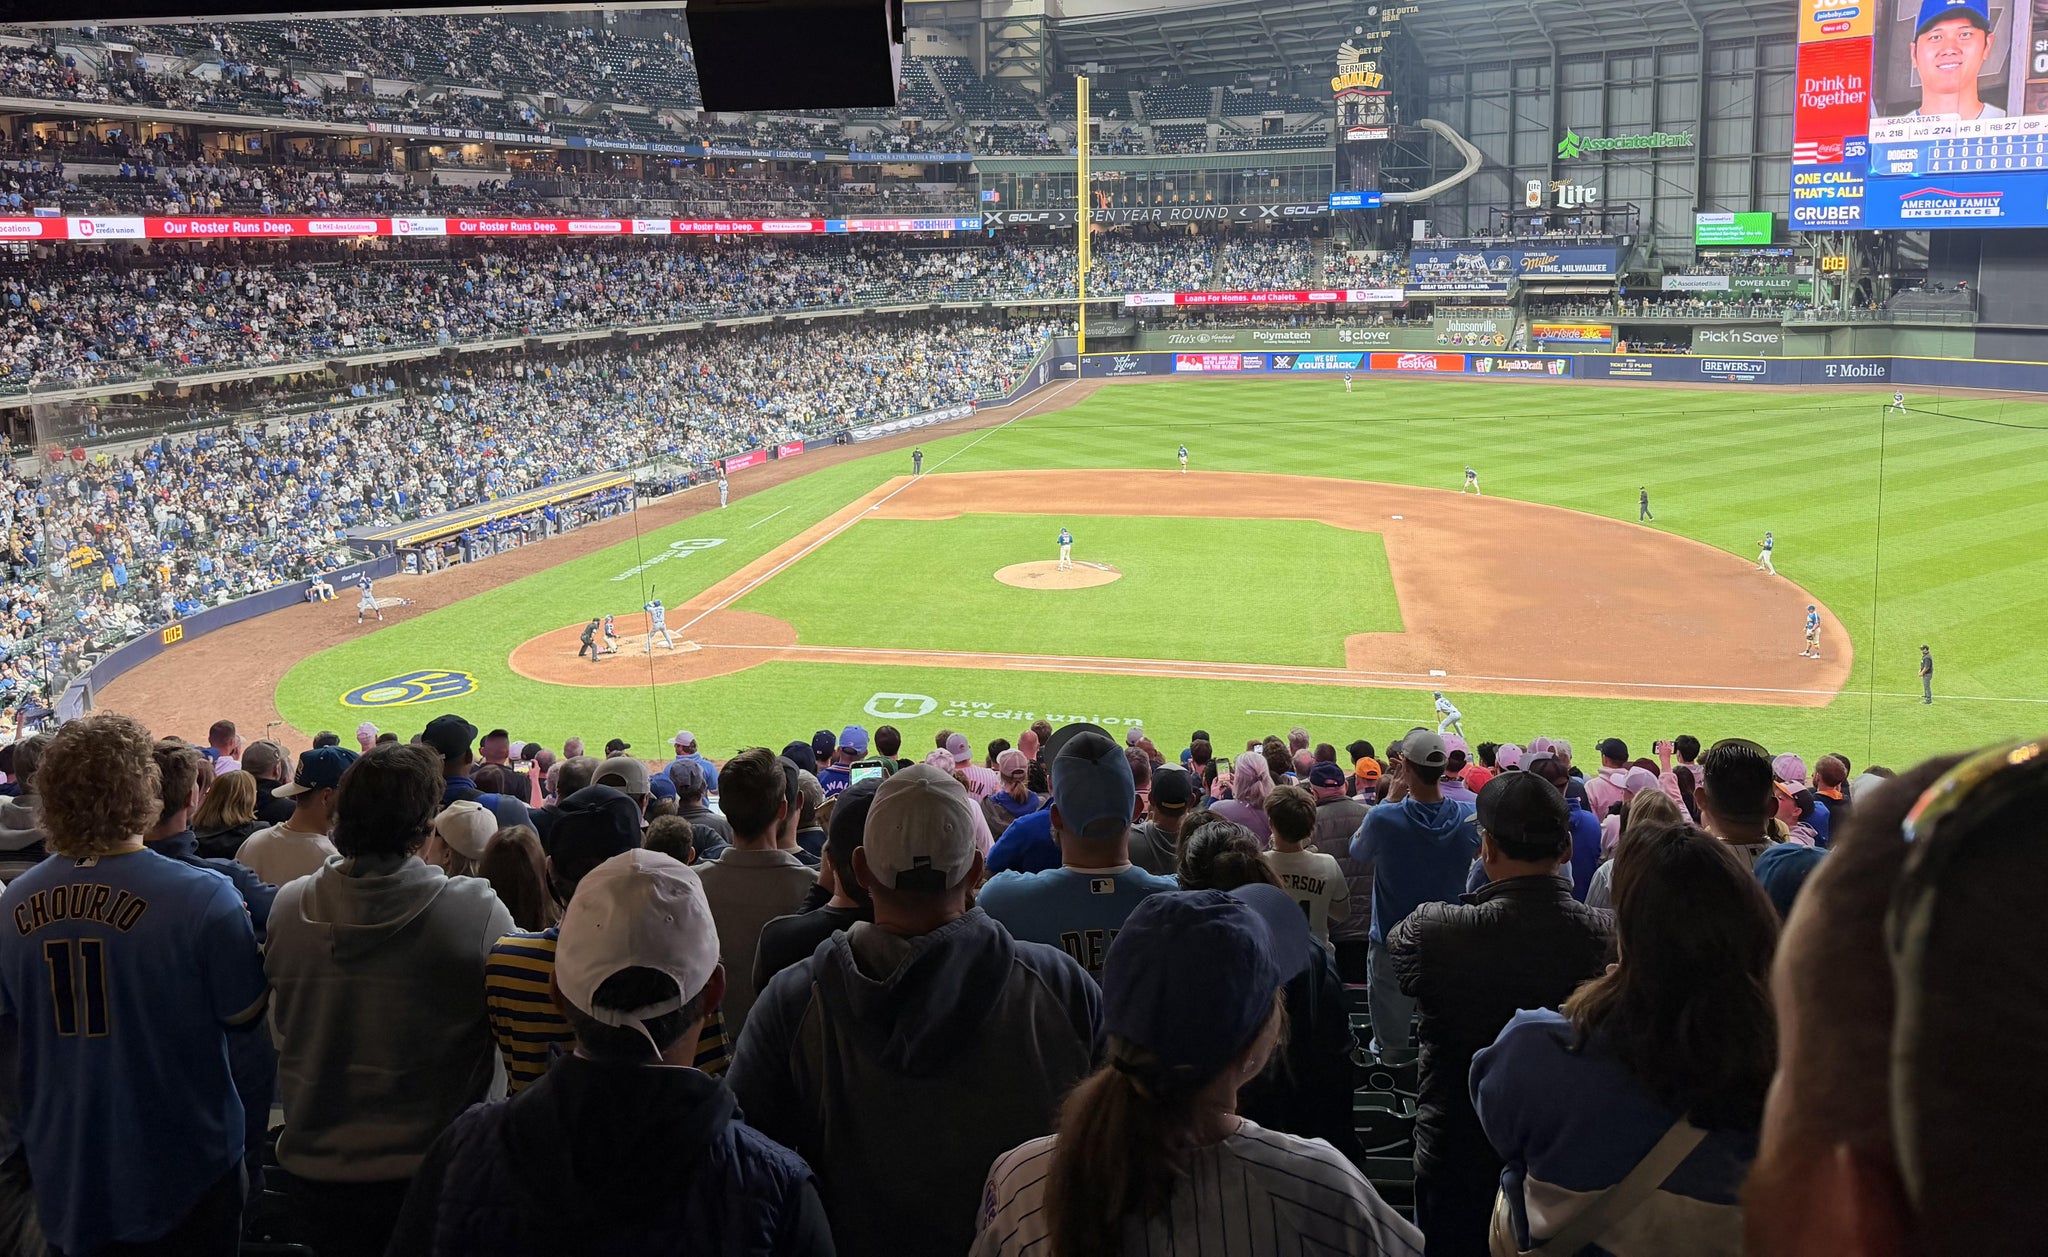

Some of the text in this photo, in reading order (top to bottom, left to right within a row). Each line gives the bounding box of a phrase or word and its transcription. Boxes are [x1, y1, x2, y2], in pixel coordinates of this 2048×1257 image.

[1397, 6, 1419, 14] OUTTA
[1340, 62, 1376, 74] BERNIE'S
[1331, 71, 1384, 92] CHALET
[1805, 74, 1862, 93] Drink in
[1800, 89, 1866, 109] Together
[1888, 116, 1915, 126] SEASON
[430, 127, 440, 136] TEXT
[1932, 127, 1952, 135] .274
[592, 140, 628, 150] Northwestern
[652, 144, 673, 152] LEGENDS
[712, 148, 751, 156] Northwestern
[1845, 146, 1866, 156] 250
[1887, 142, 2043, 161] DODGERS 0 0 0 0 0 0 1 0
[1891, 156, 2042, 172] WISCO 4 1 0 0 0 0 0 0
[1794, 172, 1864, 184] ONE CALL...
[1557, 186, 1596, 209] Lite
[1793, 186, 1864, 199] THAT'S ALL!
[1902, 198, 2000, 208] AMERICAN FAMILY
[984, 212, 1003, 224] X
[1008, 213, 1049, 222] GOLF
[1122, 209, 1162, 220] YEAR
[1170, 208, 1229, 220] ROUND
[1259, 206, 1280, 218] X
[1284, 206, 1328, 214] GOLF
[1794, 206, 1860, 220] GRUBER
[0, 224, 31, 232] ocations
[164, 222, 294, 236] Our Roster Runs Deep.
[460, 222, 558, 234] Our Roster Runs Deep.
[680, 222, 754, 232] Our Roster Runs Deep.
[1520, 255, 1560, 272] Miller
[1540, 264, 1607, 272] TIME, MILWAUKEE
[1446, 320, 1496, 332] Johnsonville
[1168, 334, 1196, 344] Tito's
[1254, 331, 1310, 341] Polymatech
[1352, 330, 1390, 340] clover
[1540, 327, 1580, 339] Surfside
[1700, 330, 1728, 342] Pick
[1742, 332, 1778, 343] Save
[1398, 356, 1437, 369] festival
[1705, 362, 1762, 372] BREWERS.TV
[1840, 364, 1885, 377] Mobile
[950, 700, 996, 710] uw
[942, 709, 1144, 728] credit union
[1281, 874, 1325, 896] ERSON
[14, 884, 147, 936] CHOURIO
[1060, 929, 1121, 971] DE
[44, 938, 109, 1037] 11
